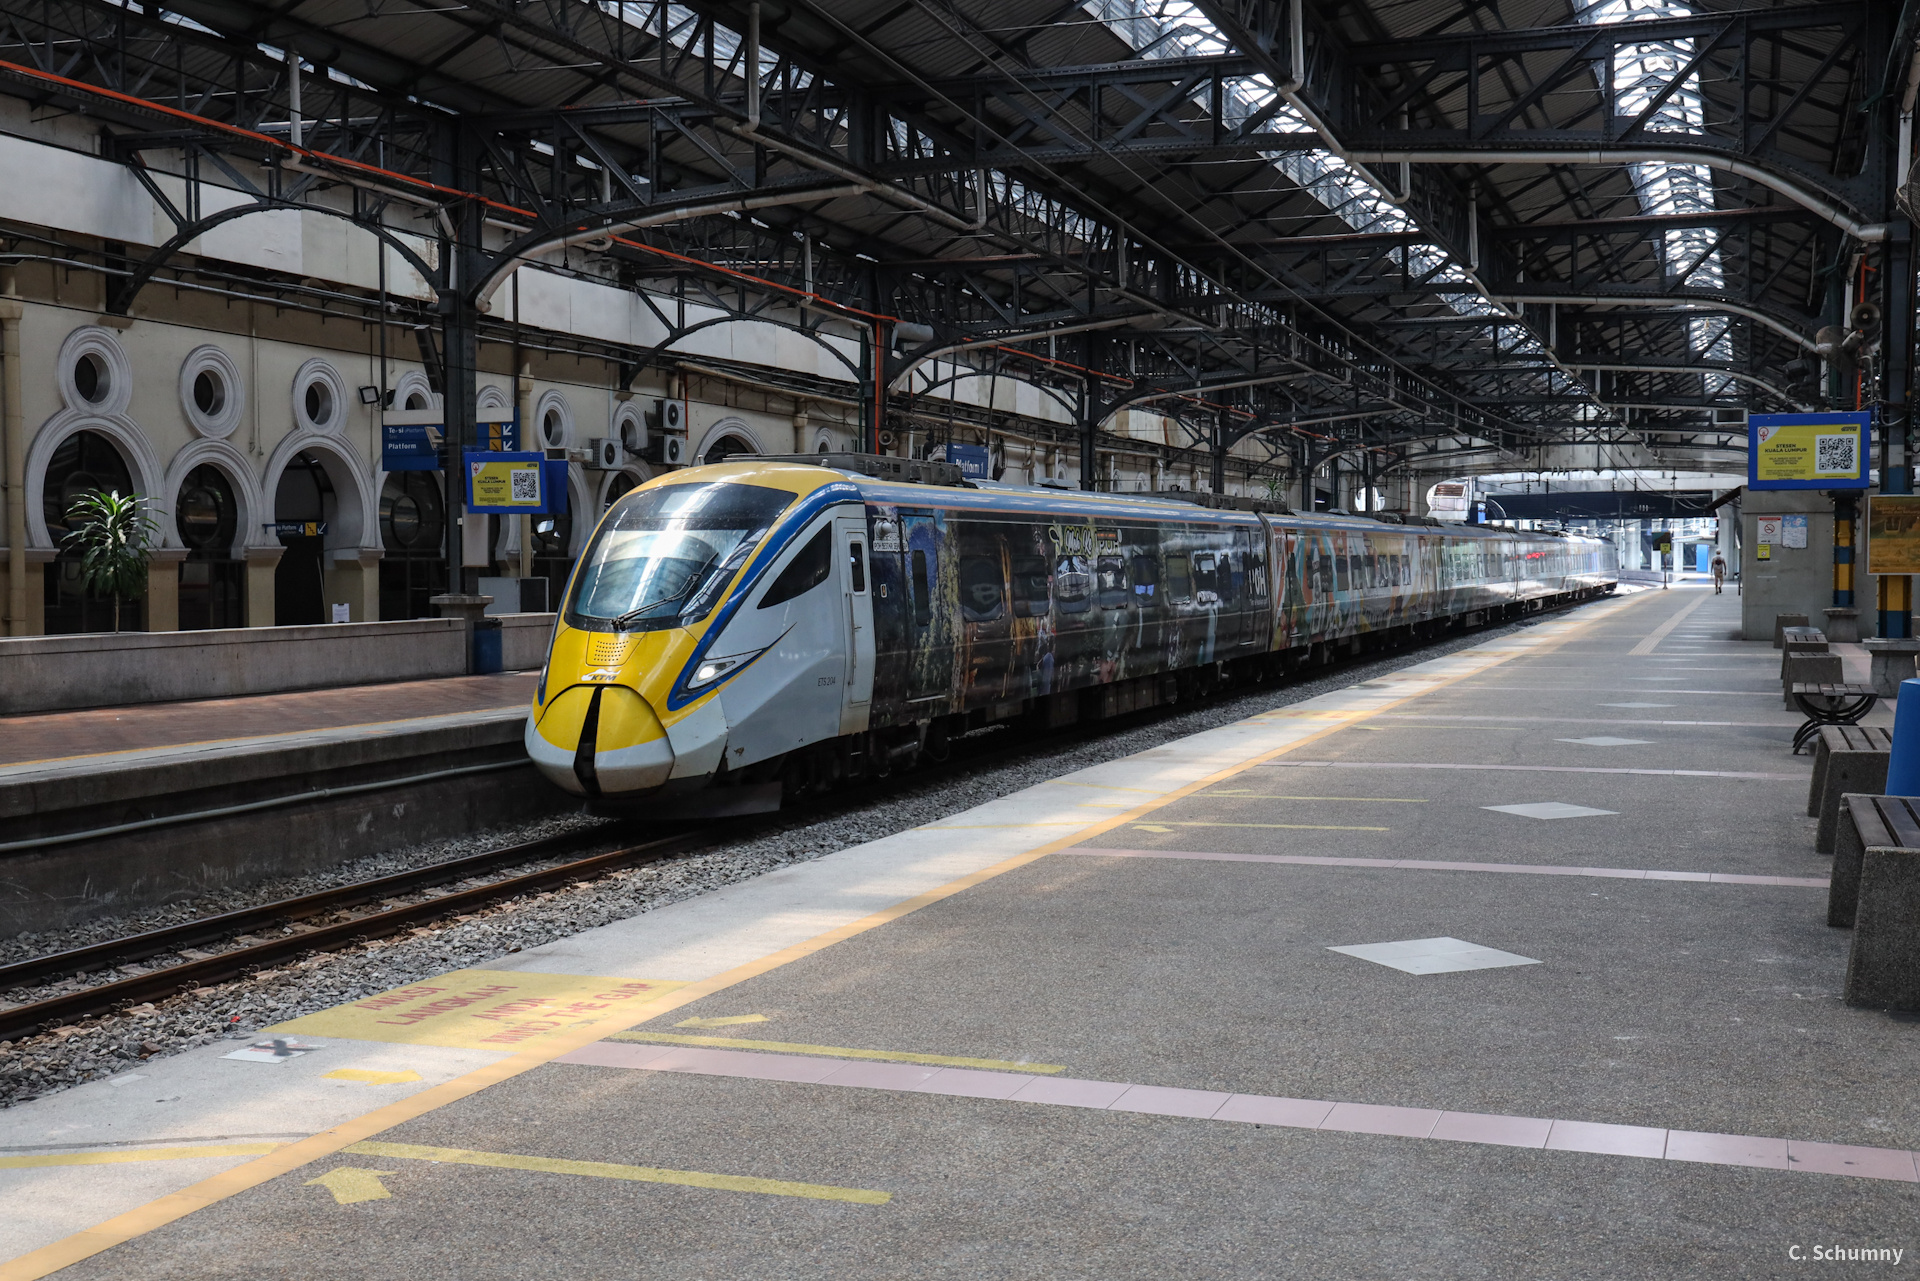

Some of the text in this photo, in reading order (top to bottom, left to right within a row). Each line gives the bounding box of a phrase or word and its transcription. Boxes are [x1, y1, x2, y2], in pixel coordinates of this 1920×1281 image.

[980, 462, 984, 474] 1
[298, 524, 304, 535] 4
[818, 676, 836, 687] ETS 204
[376, 984, 519, 1026] LANGKAH
[471, 998, 557, 1021] ANDA
[479, 983, 653, 1044] MIND THE GAP
